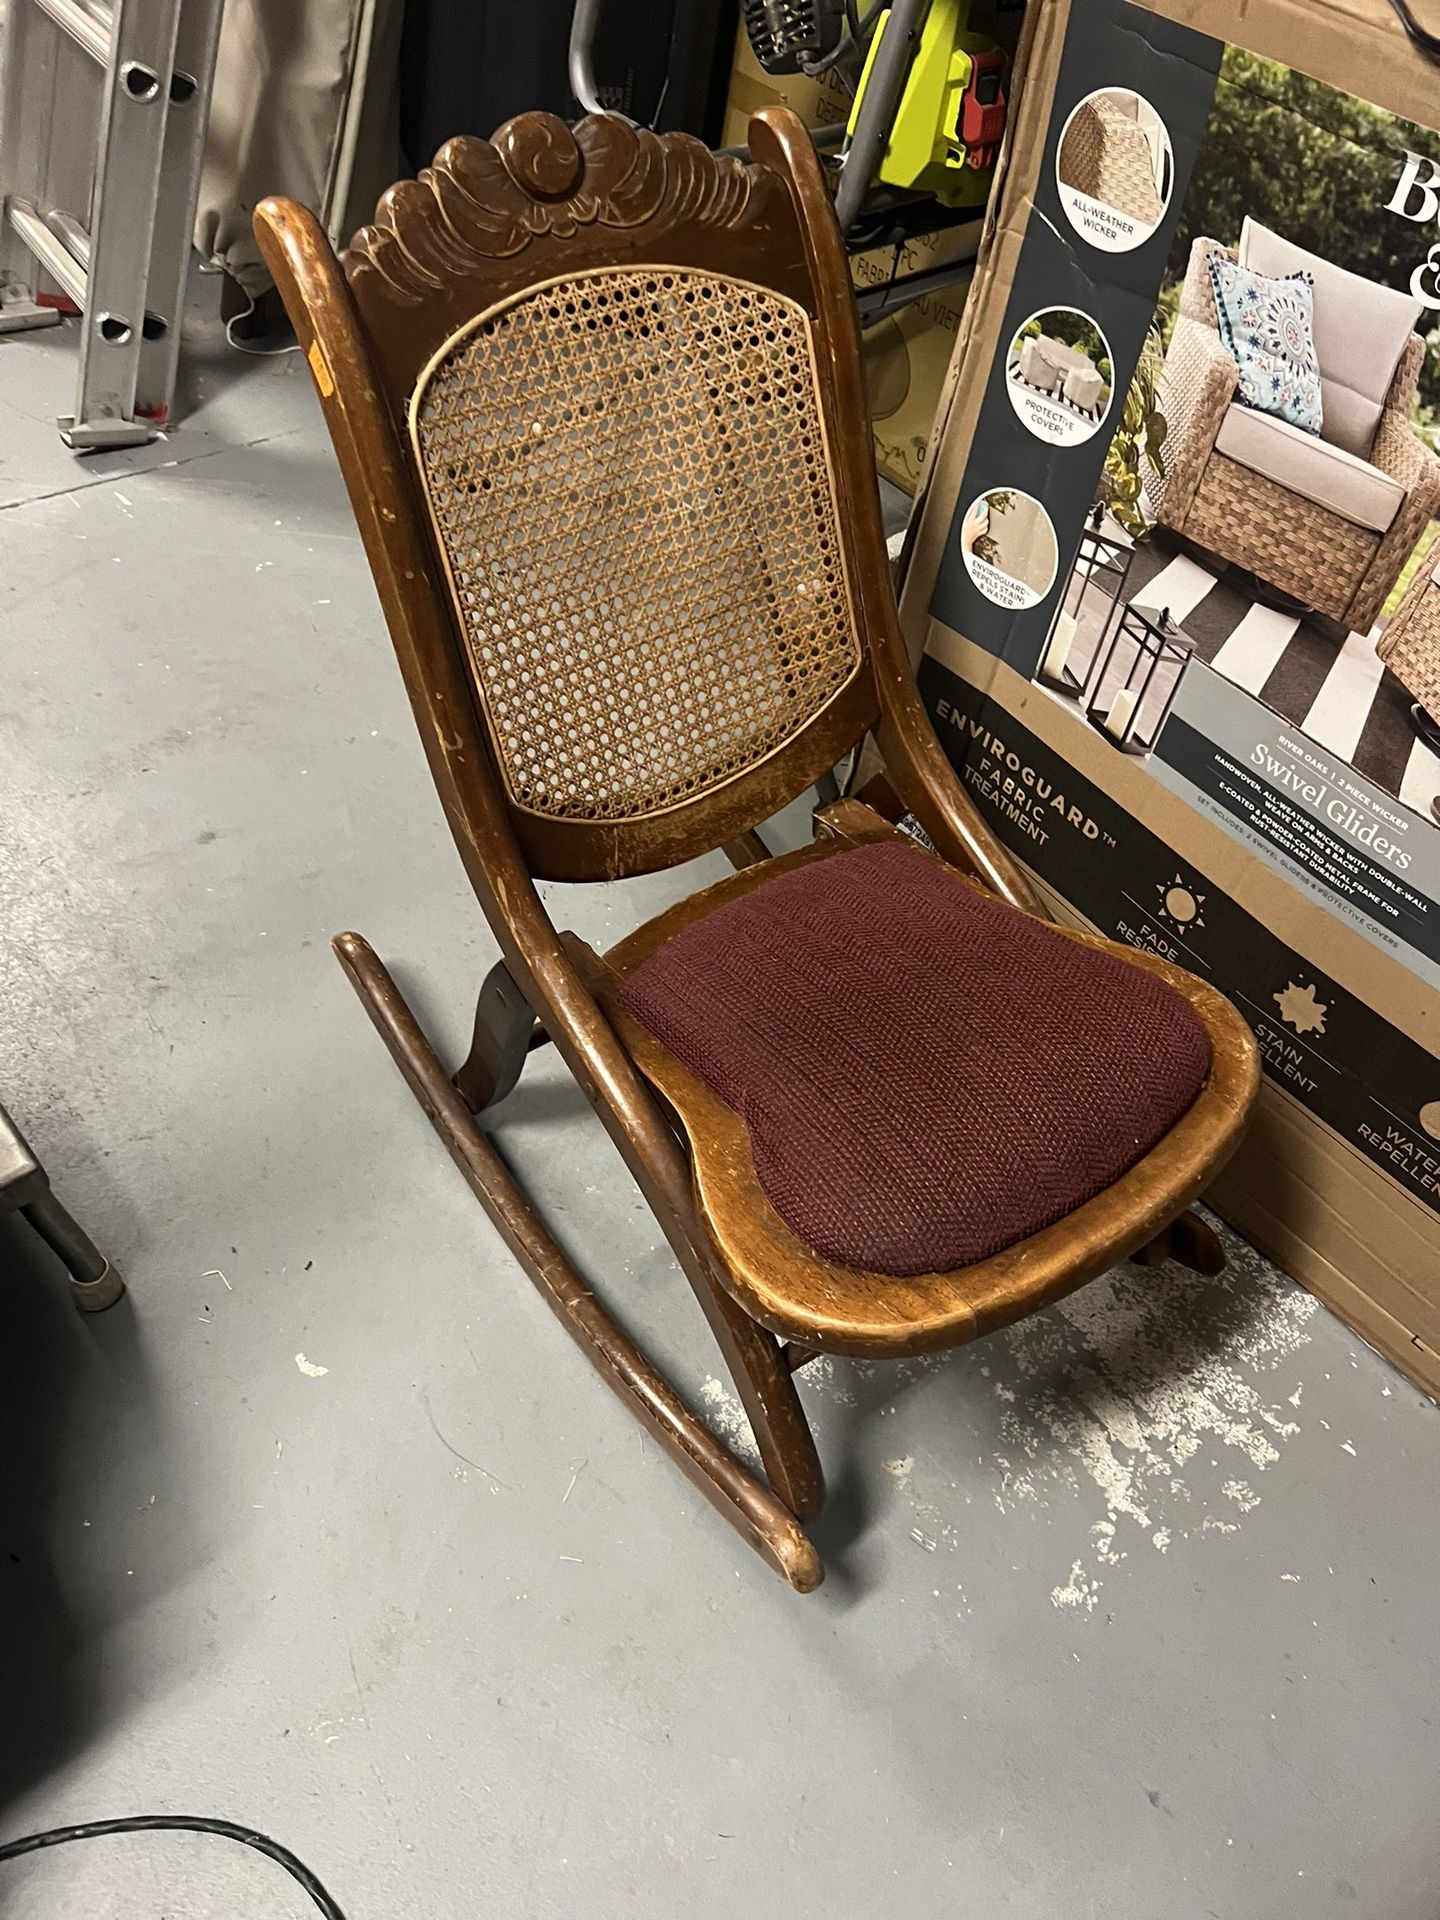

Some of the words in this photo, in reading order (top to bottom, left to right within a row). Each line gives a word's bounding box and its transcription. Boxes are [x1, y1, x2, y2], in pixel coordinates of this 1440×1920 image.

[1072, 198, 1134, 235] ALL-WEATHER
[1383, 148, 1440, 222] B
[1083, 216, 1117, 240] WICKER
[1025, 399, 1074, 431] PROTECTIVE
[1031, 413, 1064, 436] COVERS
[972, 569, 998, 589] REPELS
[986, 587, 1013, 606] WATER
[964, 764, 1049, 846] TREATMENT
[980, 758, 1045, 822] FABRIC
[1250, 744, 1327, 808] Swivel
[1327, 799, 1412, 869] Gliders
[1279, 735, 1304, 757] RIVER
[1304, 754, 1329, 774] OAKS
[1338, 778, 1346, 787] 2
[1345, 784, 1371, 806] PIECE
[1371, 802, 1409, 831] WICKER
[1214, 754, 1262, 794] HANDWOVEN,
[1263, 791, 1315, 832] ALL-WEATHER
[1316, 829, 1345, 855] WICKER
[1346, 852, 1368, 871] WITH
[1368, 868, 1428, 913] DOUBLE-WALL
[1219, 781, 1255, 811] E-COATED
[1261, 813, 1325, 865] POWDER-COATED
[1325, 862, 1350, 885] METAL
[1352, 880, 1381, 904] FRAME
[1381, 901, 1400, 918] FOR
[1249, 814, 1310, 862] RUST-RESISTANT
[1308, 860, 1355, 895] DURABILITY
[1264, 800, 1291, 824] WEAVE
[1291, 820, 1304, 833] ON
[1304, 831, 1325, 850] ARMS
[1325, 847, 1331, 855] &
[1331, 851, 1359, 874] BACKS
[1197, 795, 1210, 807] SET
[1252, 837, 1278, 861] SWIVEL
[1280, 859, 1310, 884] GLIDERS
[1317, 887, 1364, 925] PROTECTIVE
[1366, 923, 1399, 949] COVERS
[1116, 920, 1157, 955] RESIS
[1140, 924, 1179, 962] FADE
[1255, 1024, 1303, 1065] STAIN
[1258, 1041, 1319, 1093] ELLENT
[1357, 1123, 1440, 1198] REPELLEN
